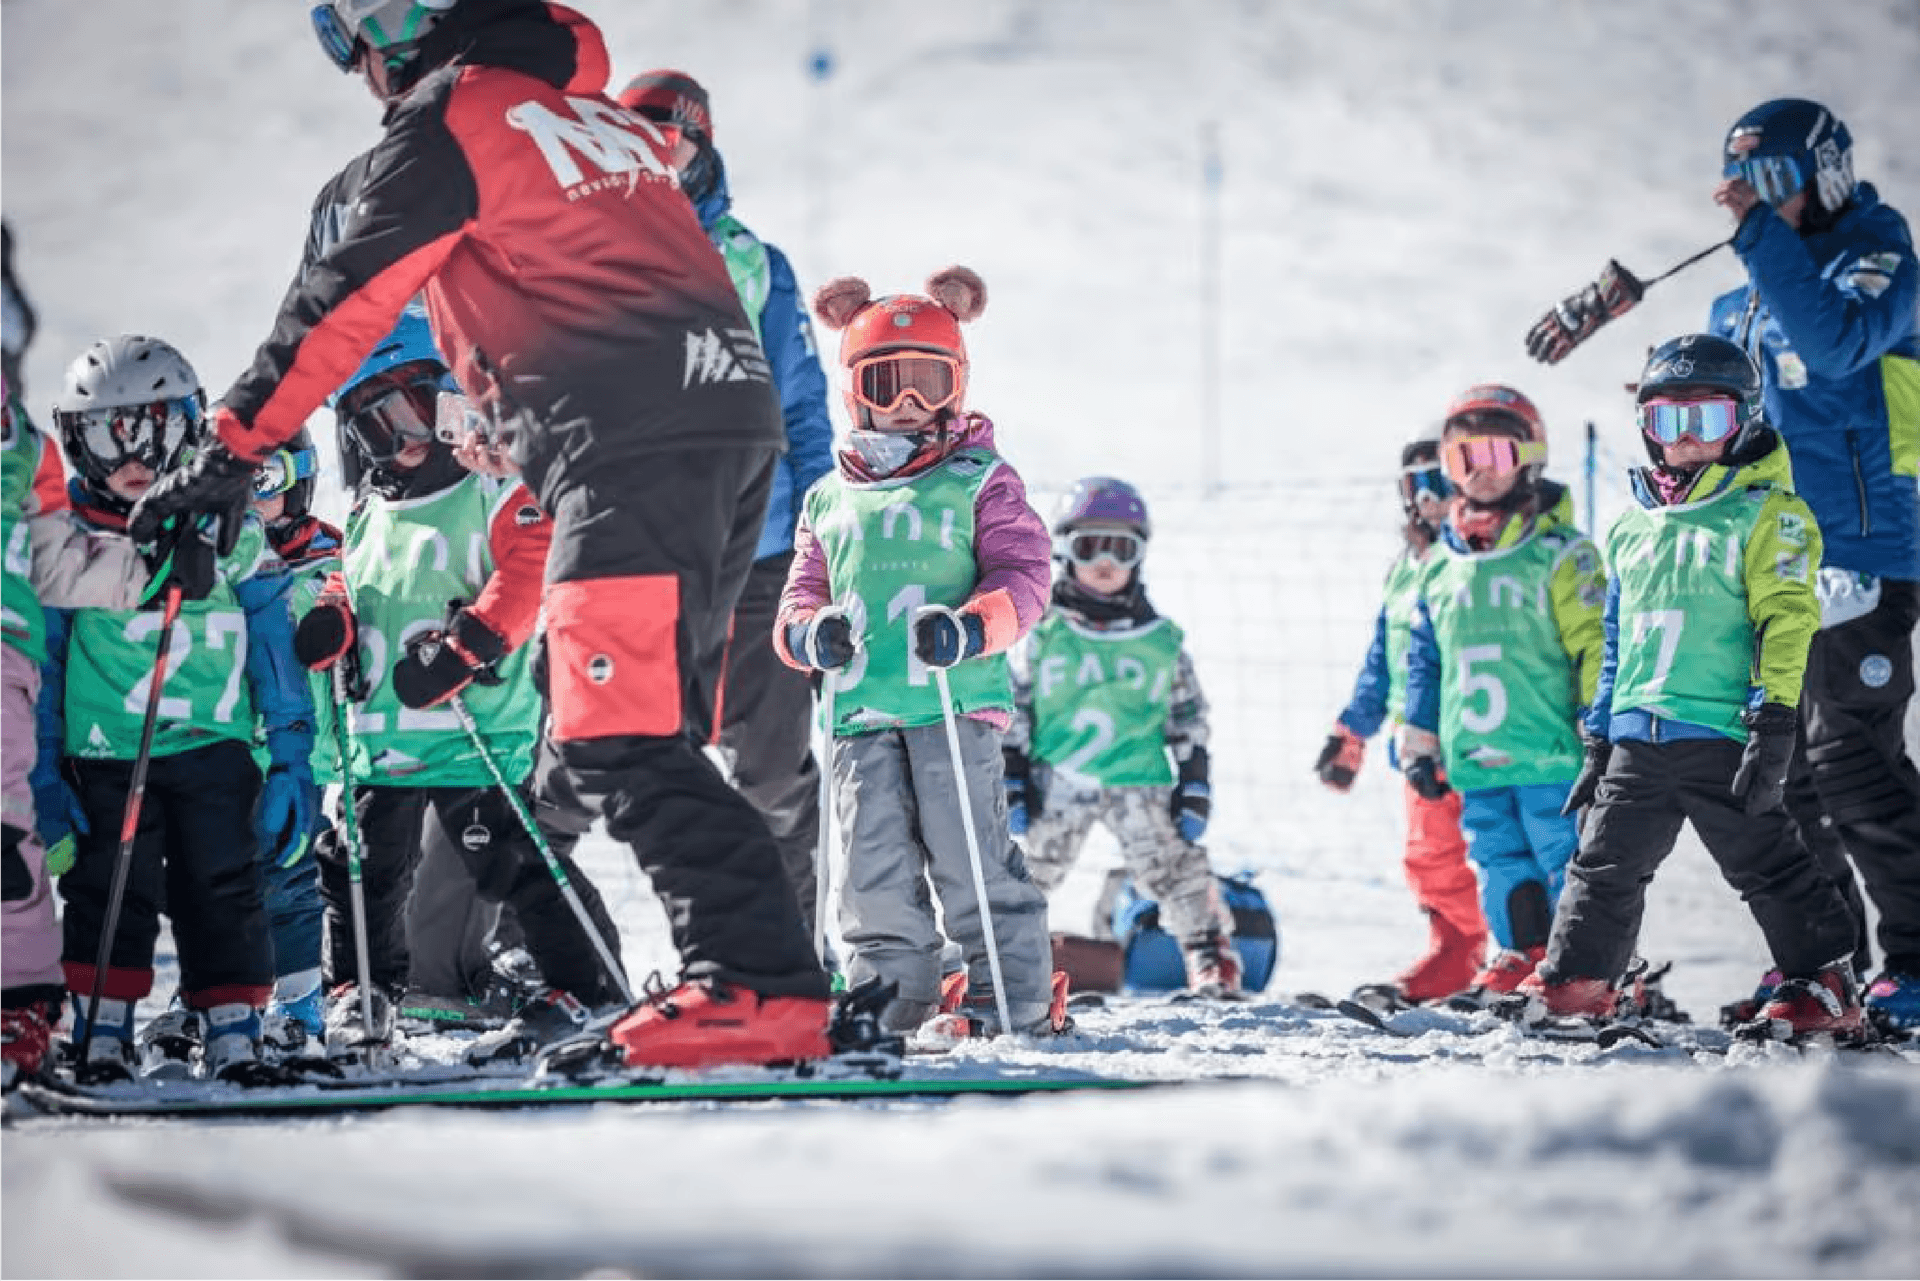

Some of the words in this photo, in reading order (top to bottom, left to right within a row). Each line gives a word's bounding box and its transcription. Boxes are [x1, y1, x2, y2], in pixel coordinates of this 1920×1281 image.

[123, 611, 248, 724] 27
[1458, 644, 1509, 735] 5
[1632, 608, 1685, 695] 7
[1052, 706, 1116, 787] 2
